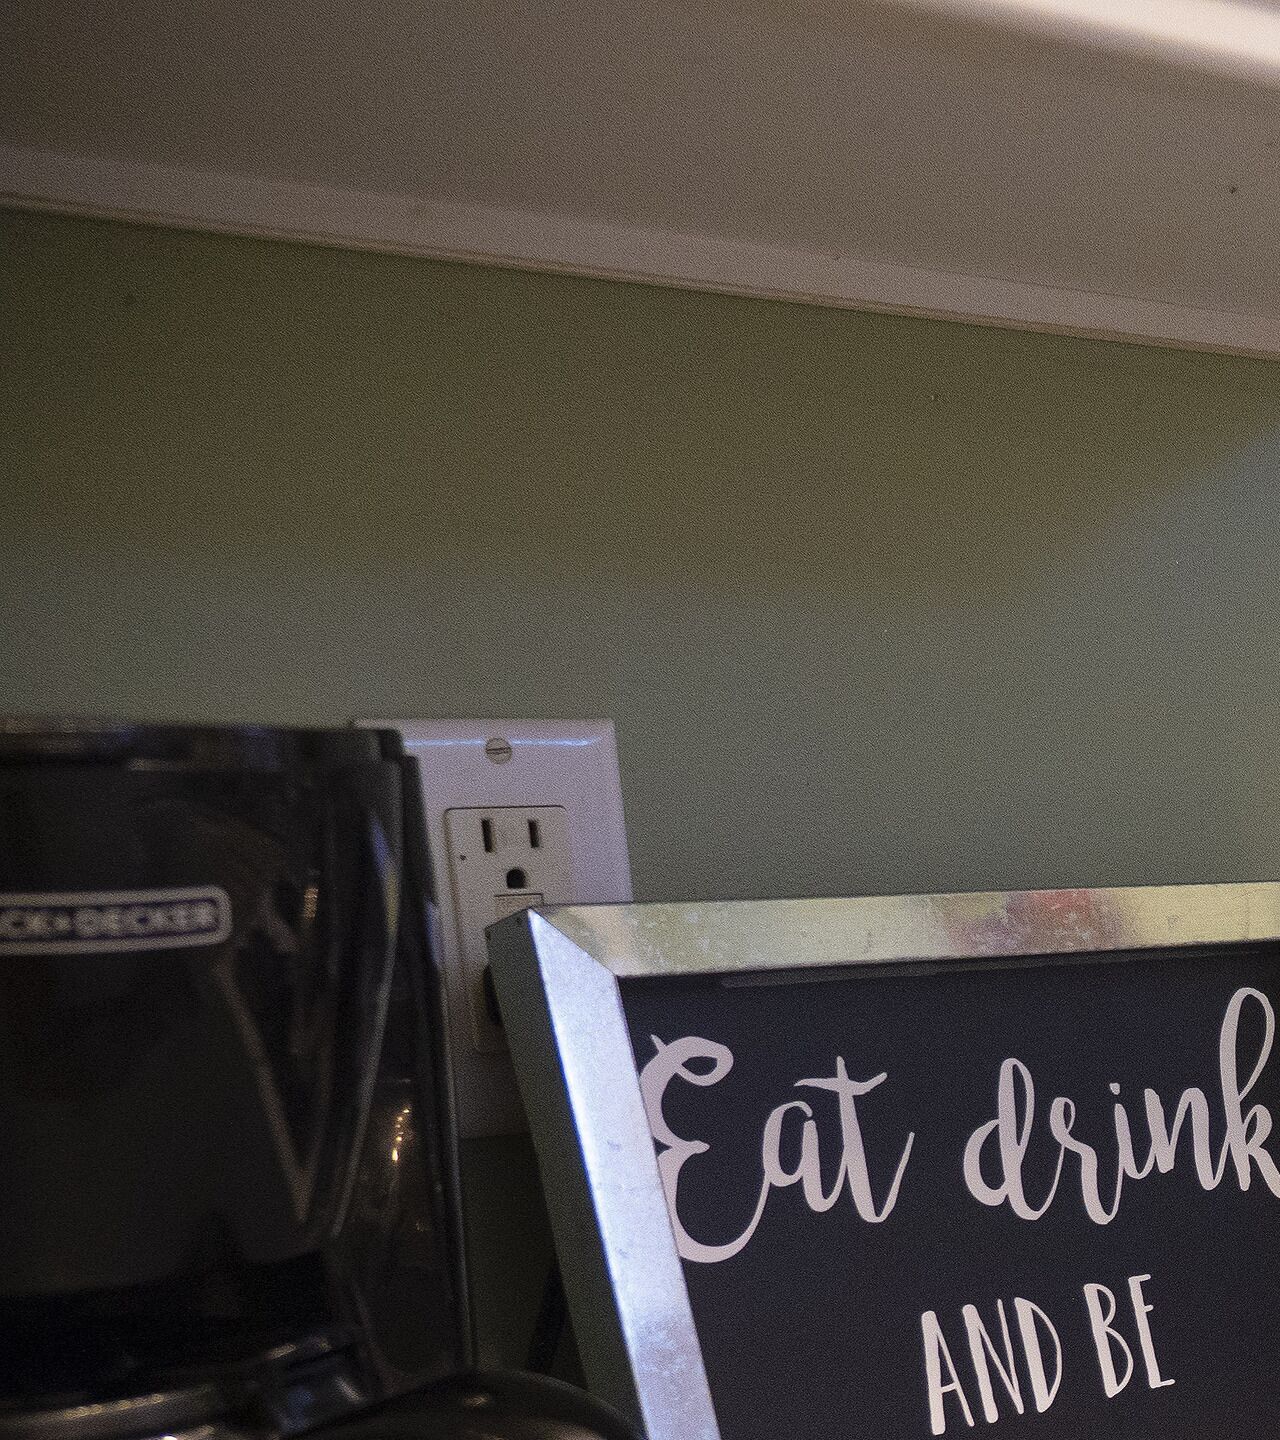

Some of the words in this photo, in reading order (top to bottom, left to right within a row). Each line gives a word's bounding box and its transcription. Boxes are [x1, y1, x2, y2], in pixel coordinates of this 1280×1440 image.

[640, 1033, 916, 1263] Eat
[921, 1298, 1064, 1436] AND
[1083, 1273, 1176, 1398] BE
